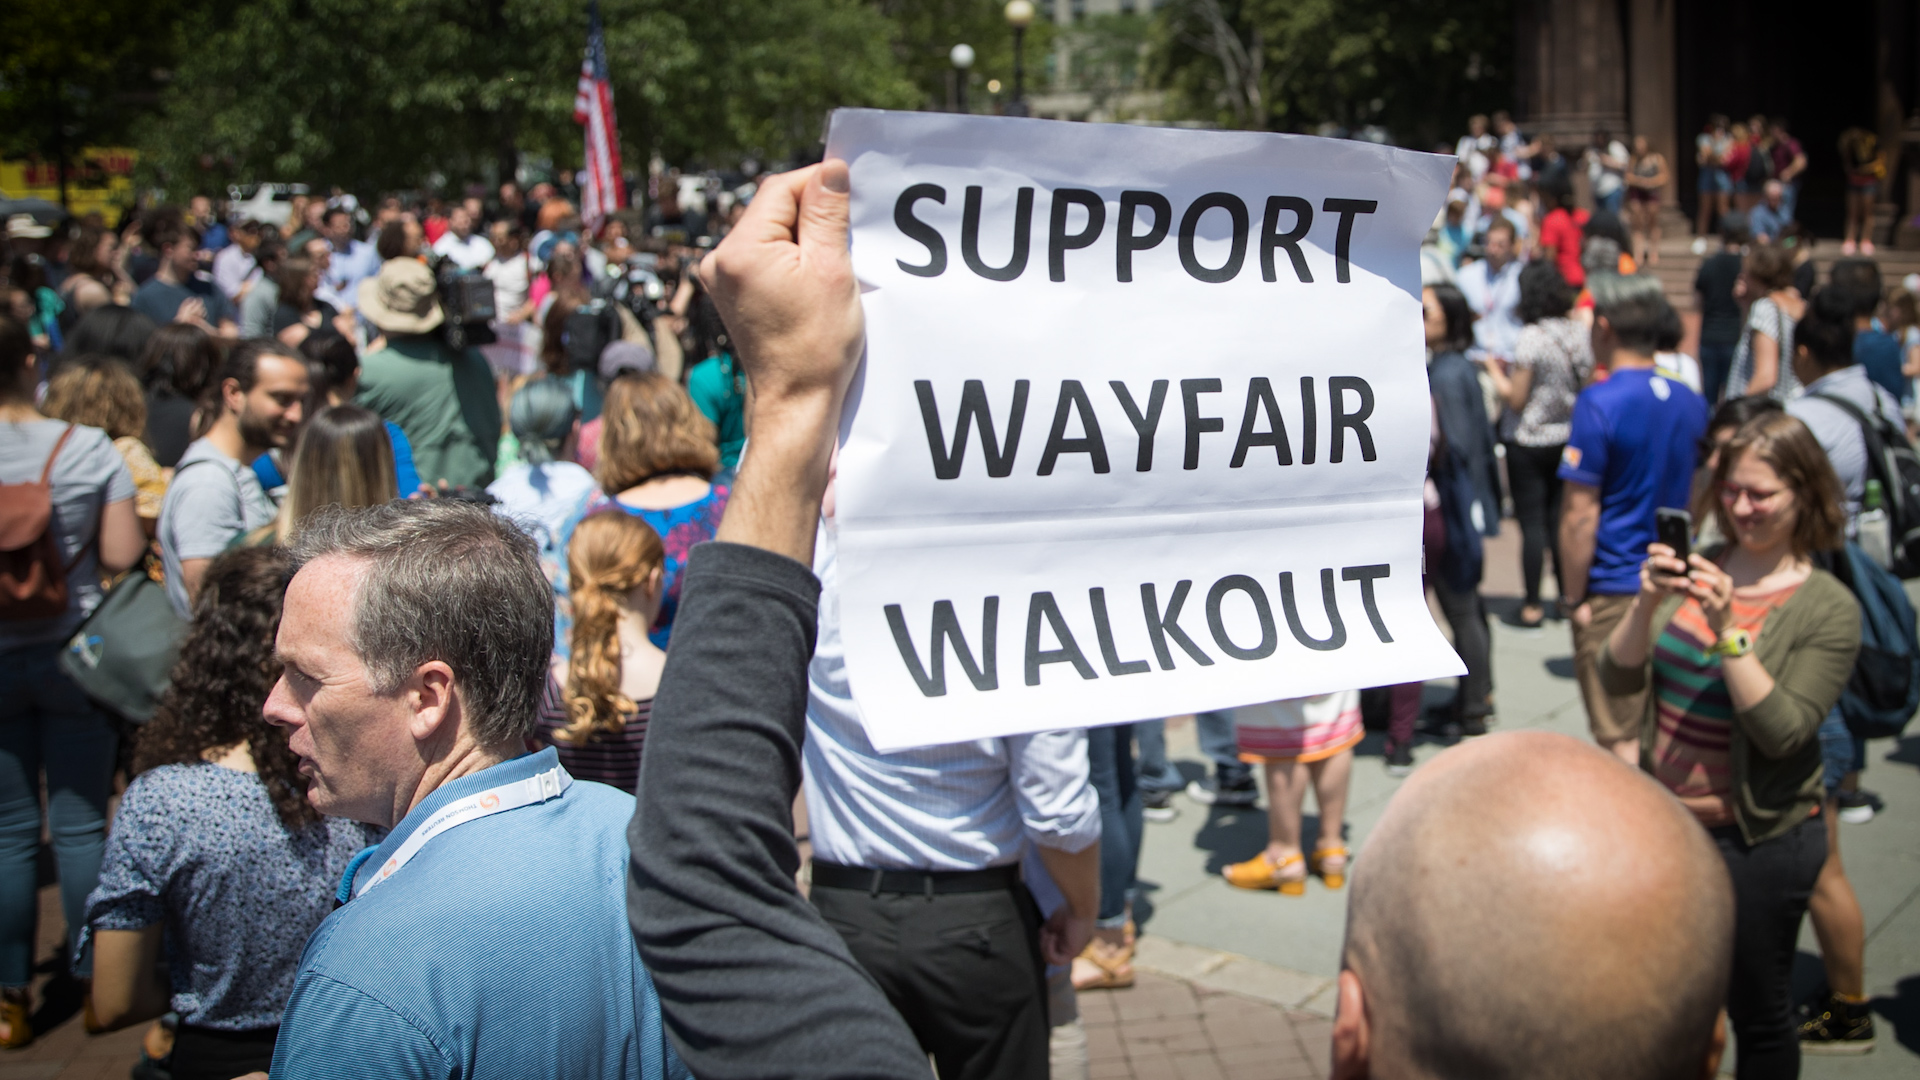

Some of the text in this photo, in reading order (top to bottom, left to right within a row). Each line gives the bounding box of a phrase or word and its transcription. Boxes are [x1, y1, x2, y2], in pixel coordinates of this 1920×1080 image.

[893, 182, 1379, 284] SUPPORT
[913, 376, 1377, 479] WAYFAIR
[883, 563, 1394, 698] WALKOUT
[421, 804, 477, 836] THOMSON REUTERS
